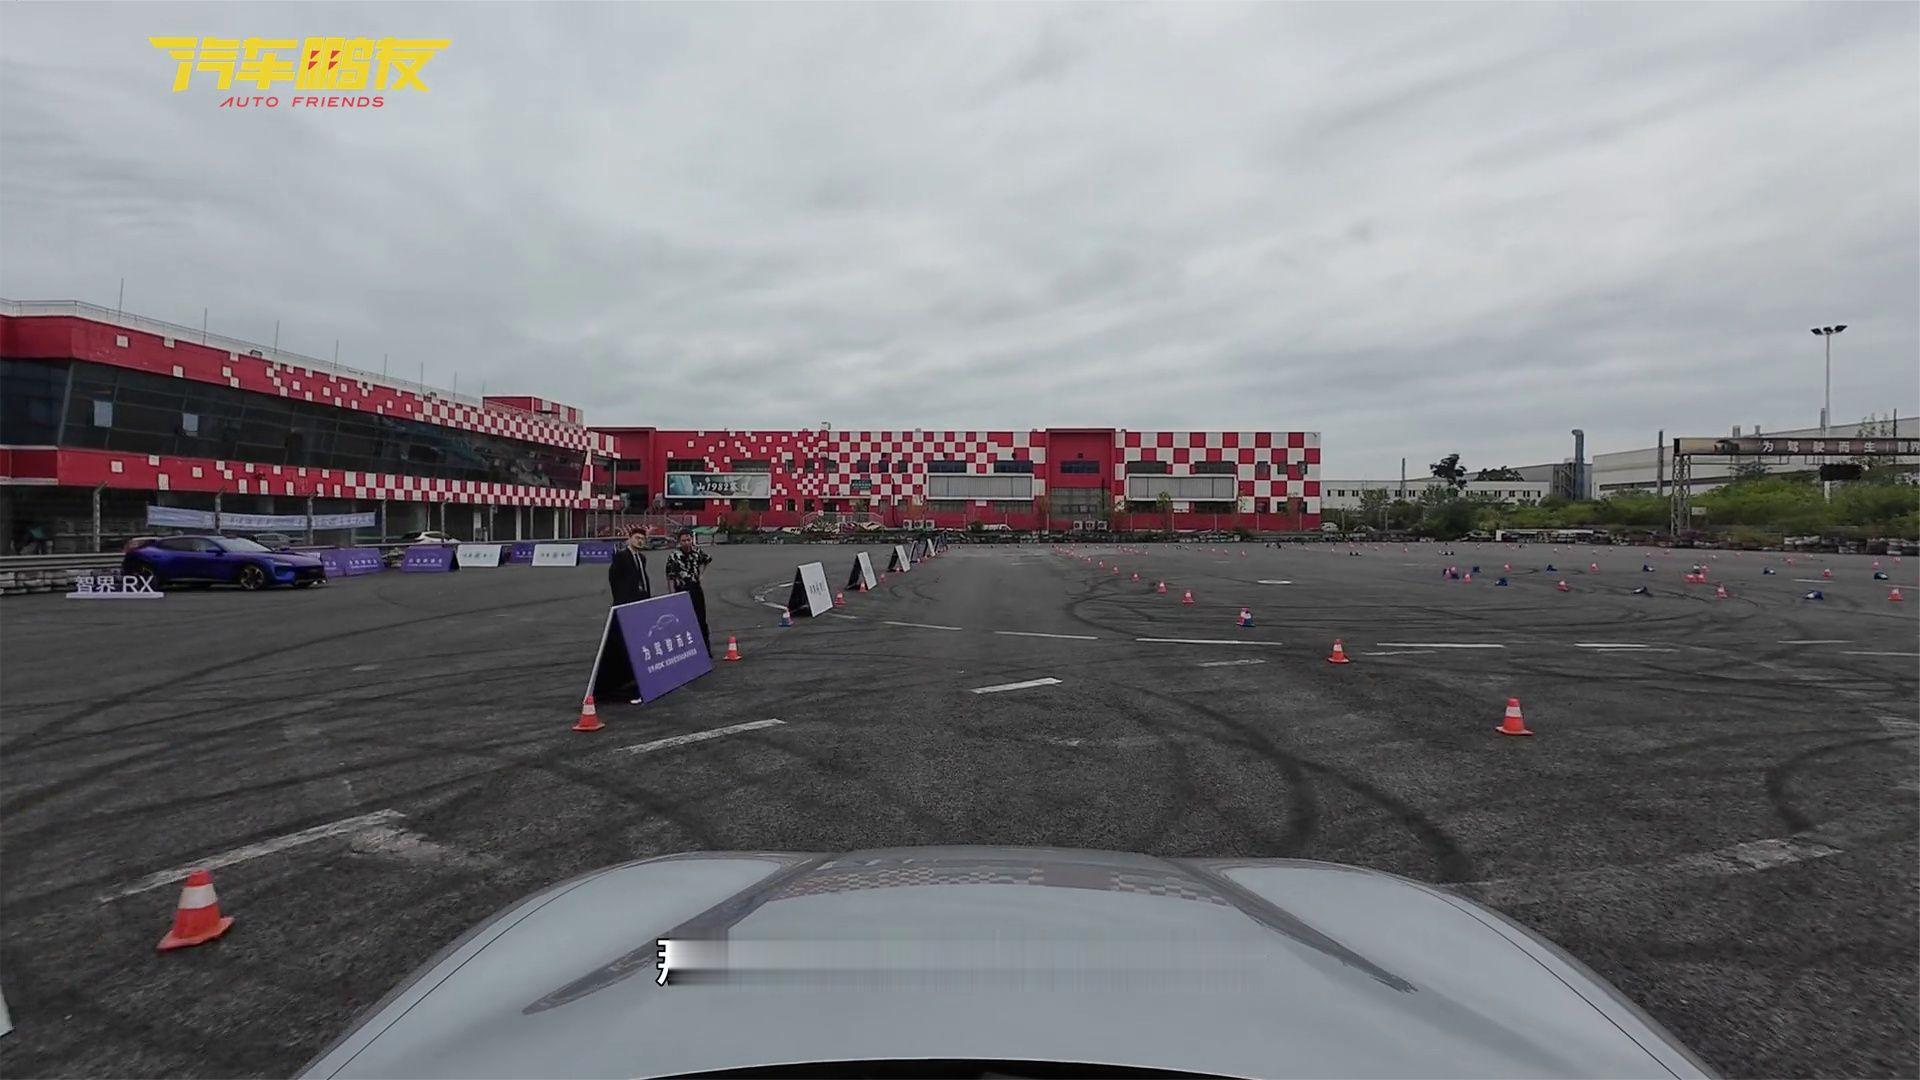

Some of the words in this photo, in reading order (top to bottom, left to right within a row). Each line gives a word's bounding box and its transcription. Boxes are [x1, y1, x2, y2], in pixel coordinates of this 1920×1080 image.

[1762, 440, 1876, 453] 为驾驶而生
[75, 575, 116, 593] 智界
[122, 575, 155, 593] RX
